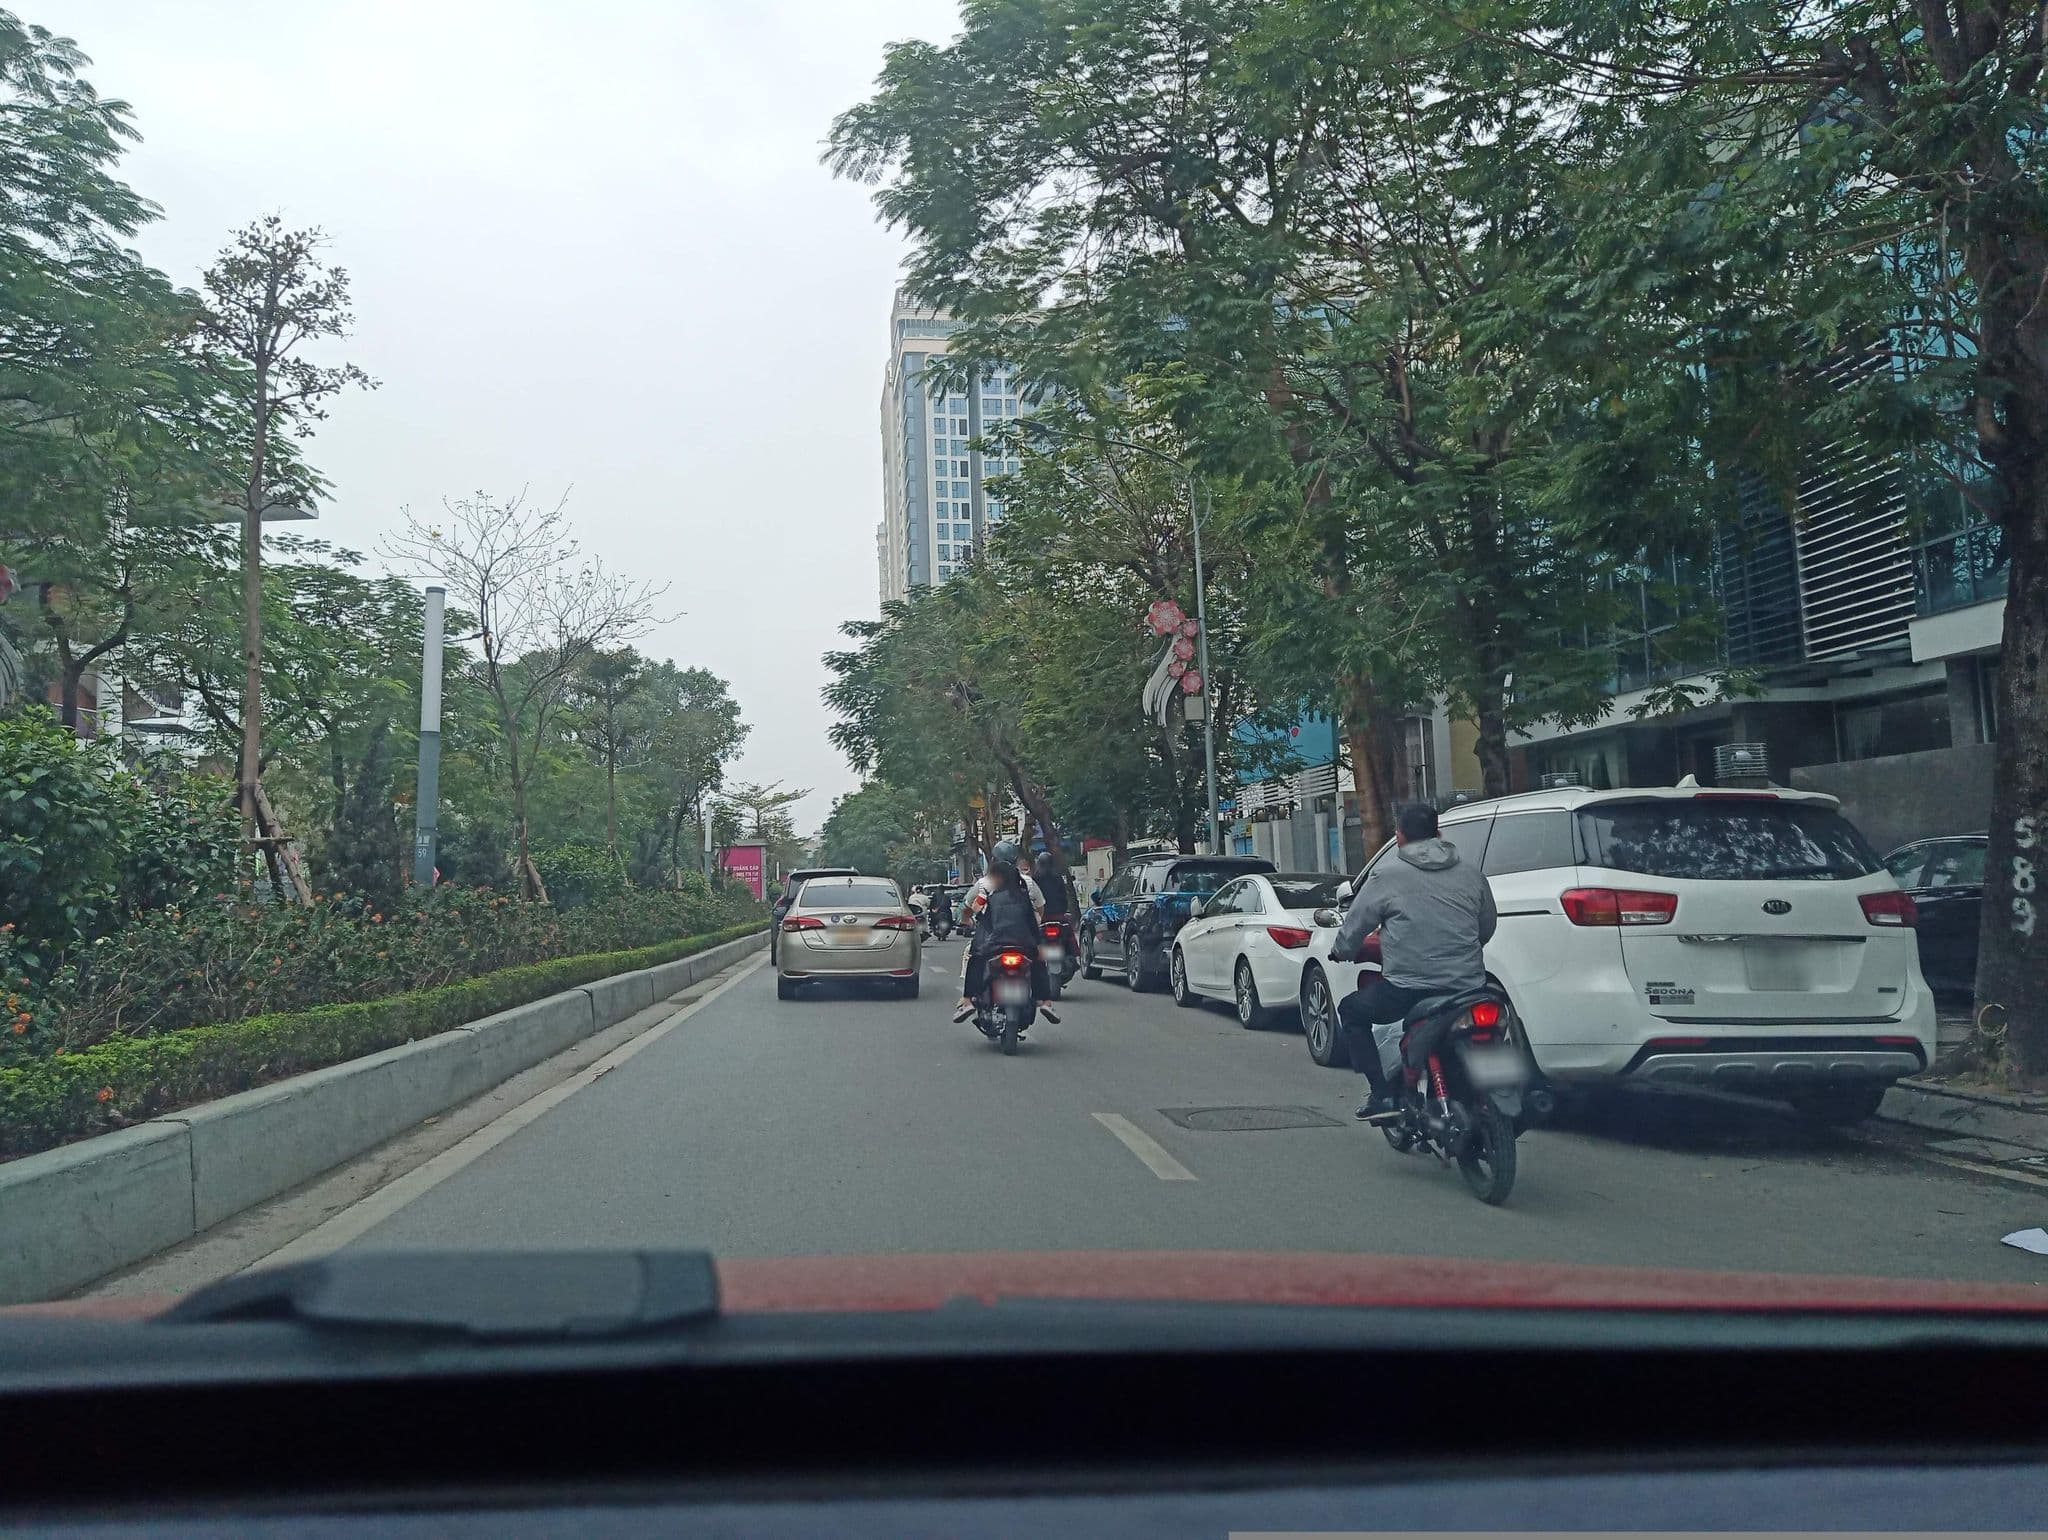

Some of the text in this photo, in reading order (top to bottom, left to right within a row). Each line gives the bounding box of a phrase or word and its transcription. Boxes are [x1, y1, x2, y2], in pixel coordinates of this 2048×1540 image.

[2013, 816, 2037, 936] 589
[1766, 901, 1789, 913] KIA
[1644, 987, 1696, 995] SEDONA
